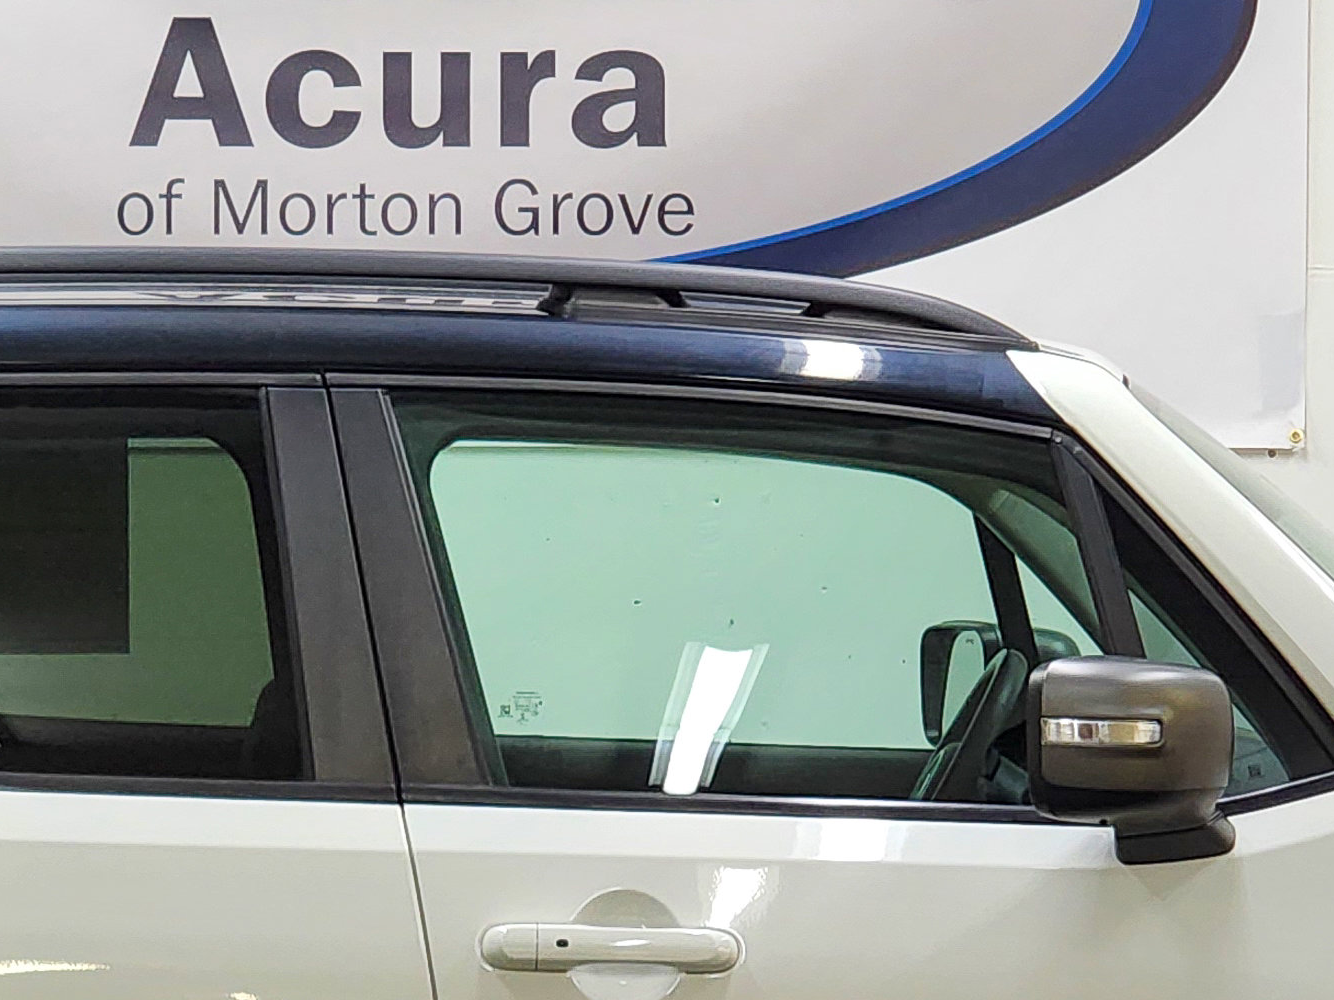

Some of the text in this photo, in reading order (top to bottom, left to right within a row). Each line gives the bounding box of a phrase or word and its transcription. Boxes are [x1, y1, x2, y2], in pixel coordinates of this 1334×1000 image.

[129, 16, 668, 150] Acura
[117, 177, 695, 237] of Morton Grove
